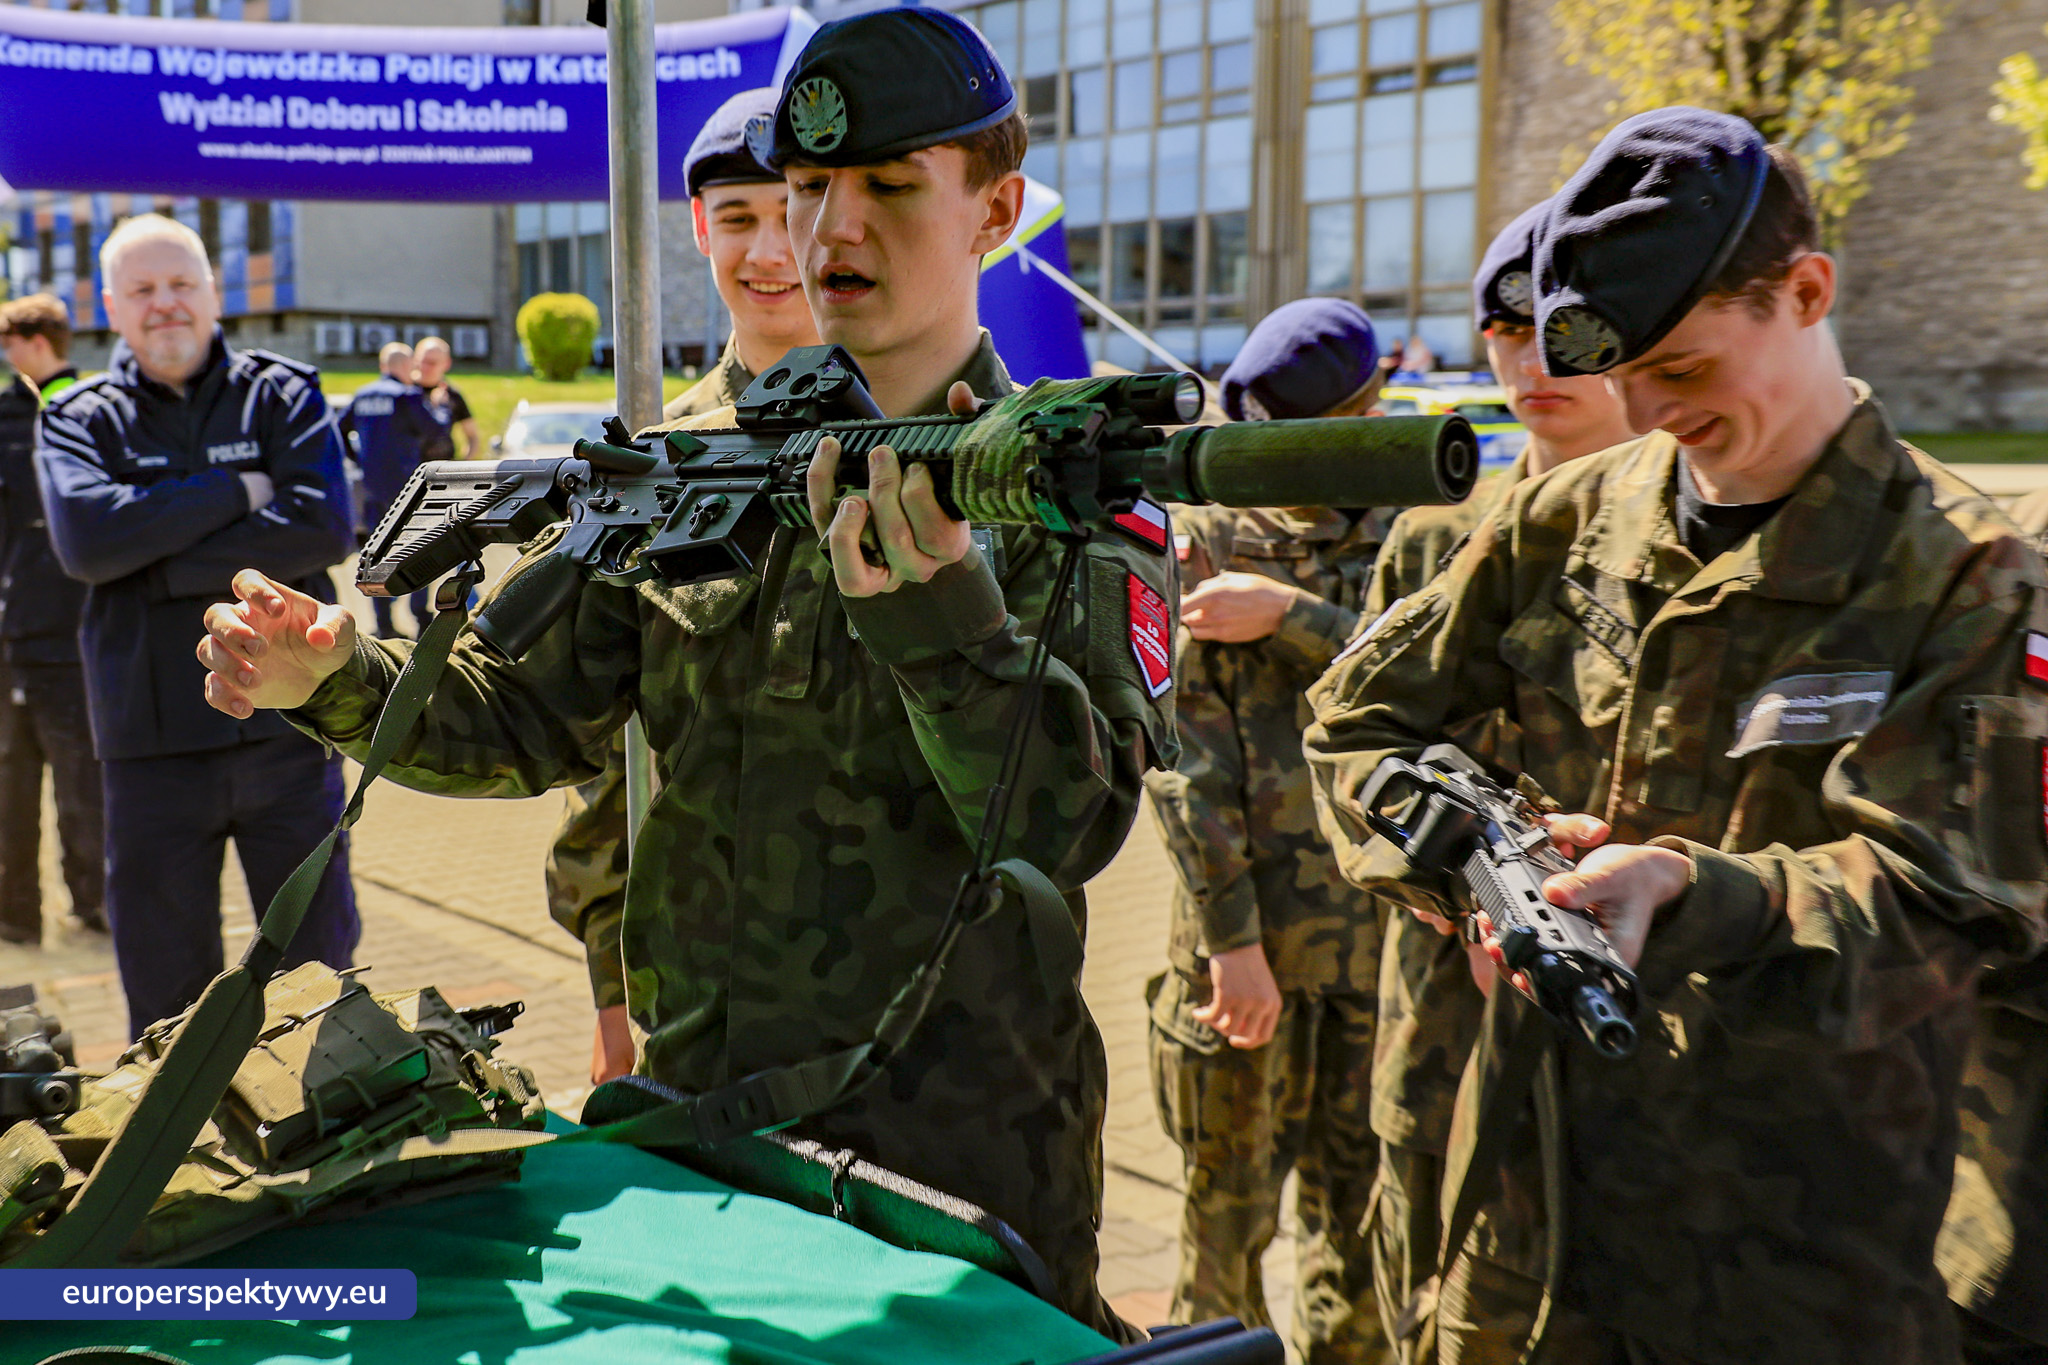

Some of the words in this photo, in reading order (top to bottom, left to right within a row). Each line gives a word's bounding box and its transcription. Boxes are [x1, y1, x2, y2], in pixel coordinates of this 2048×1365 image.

[157, 46, 381, 85] Wojewódzka
[384, 54, 495, 91] Policji
[499, 57, 532, 84] w
[159, 91, 284, 131] Wydział
[286, 96, 398, 130] Doboru
[404, 99, 416, 131] i
[418, 99, 568, 132] Szkolenia
[207, 440, 259, 464] POLICJ
